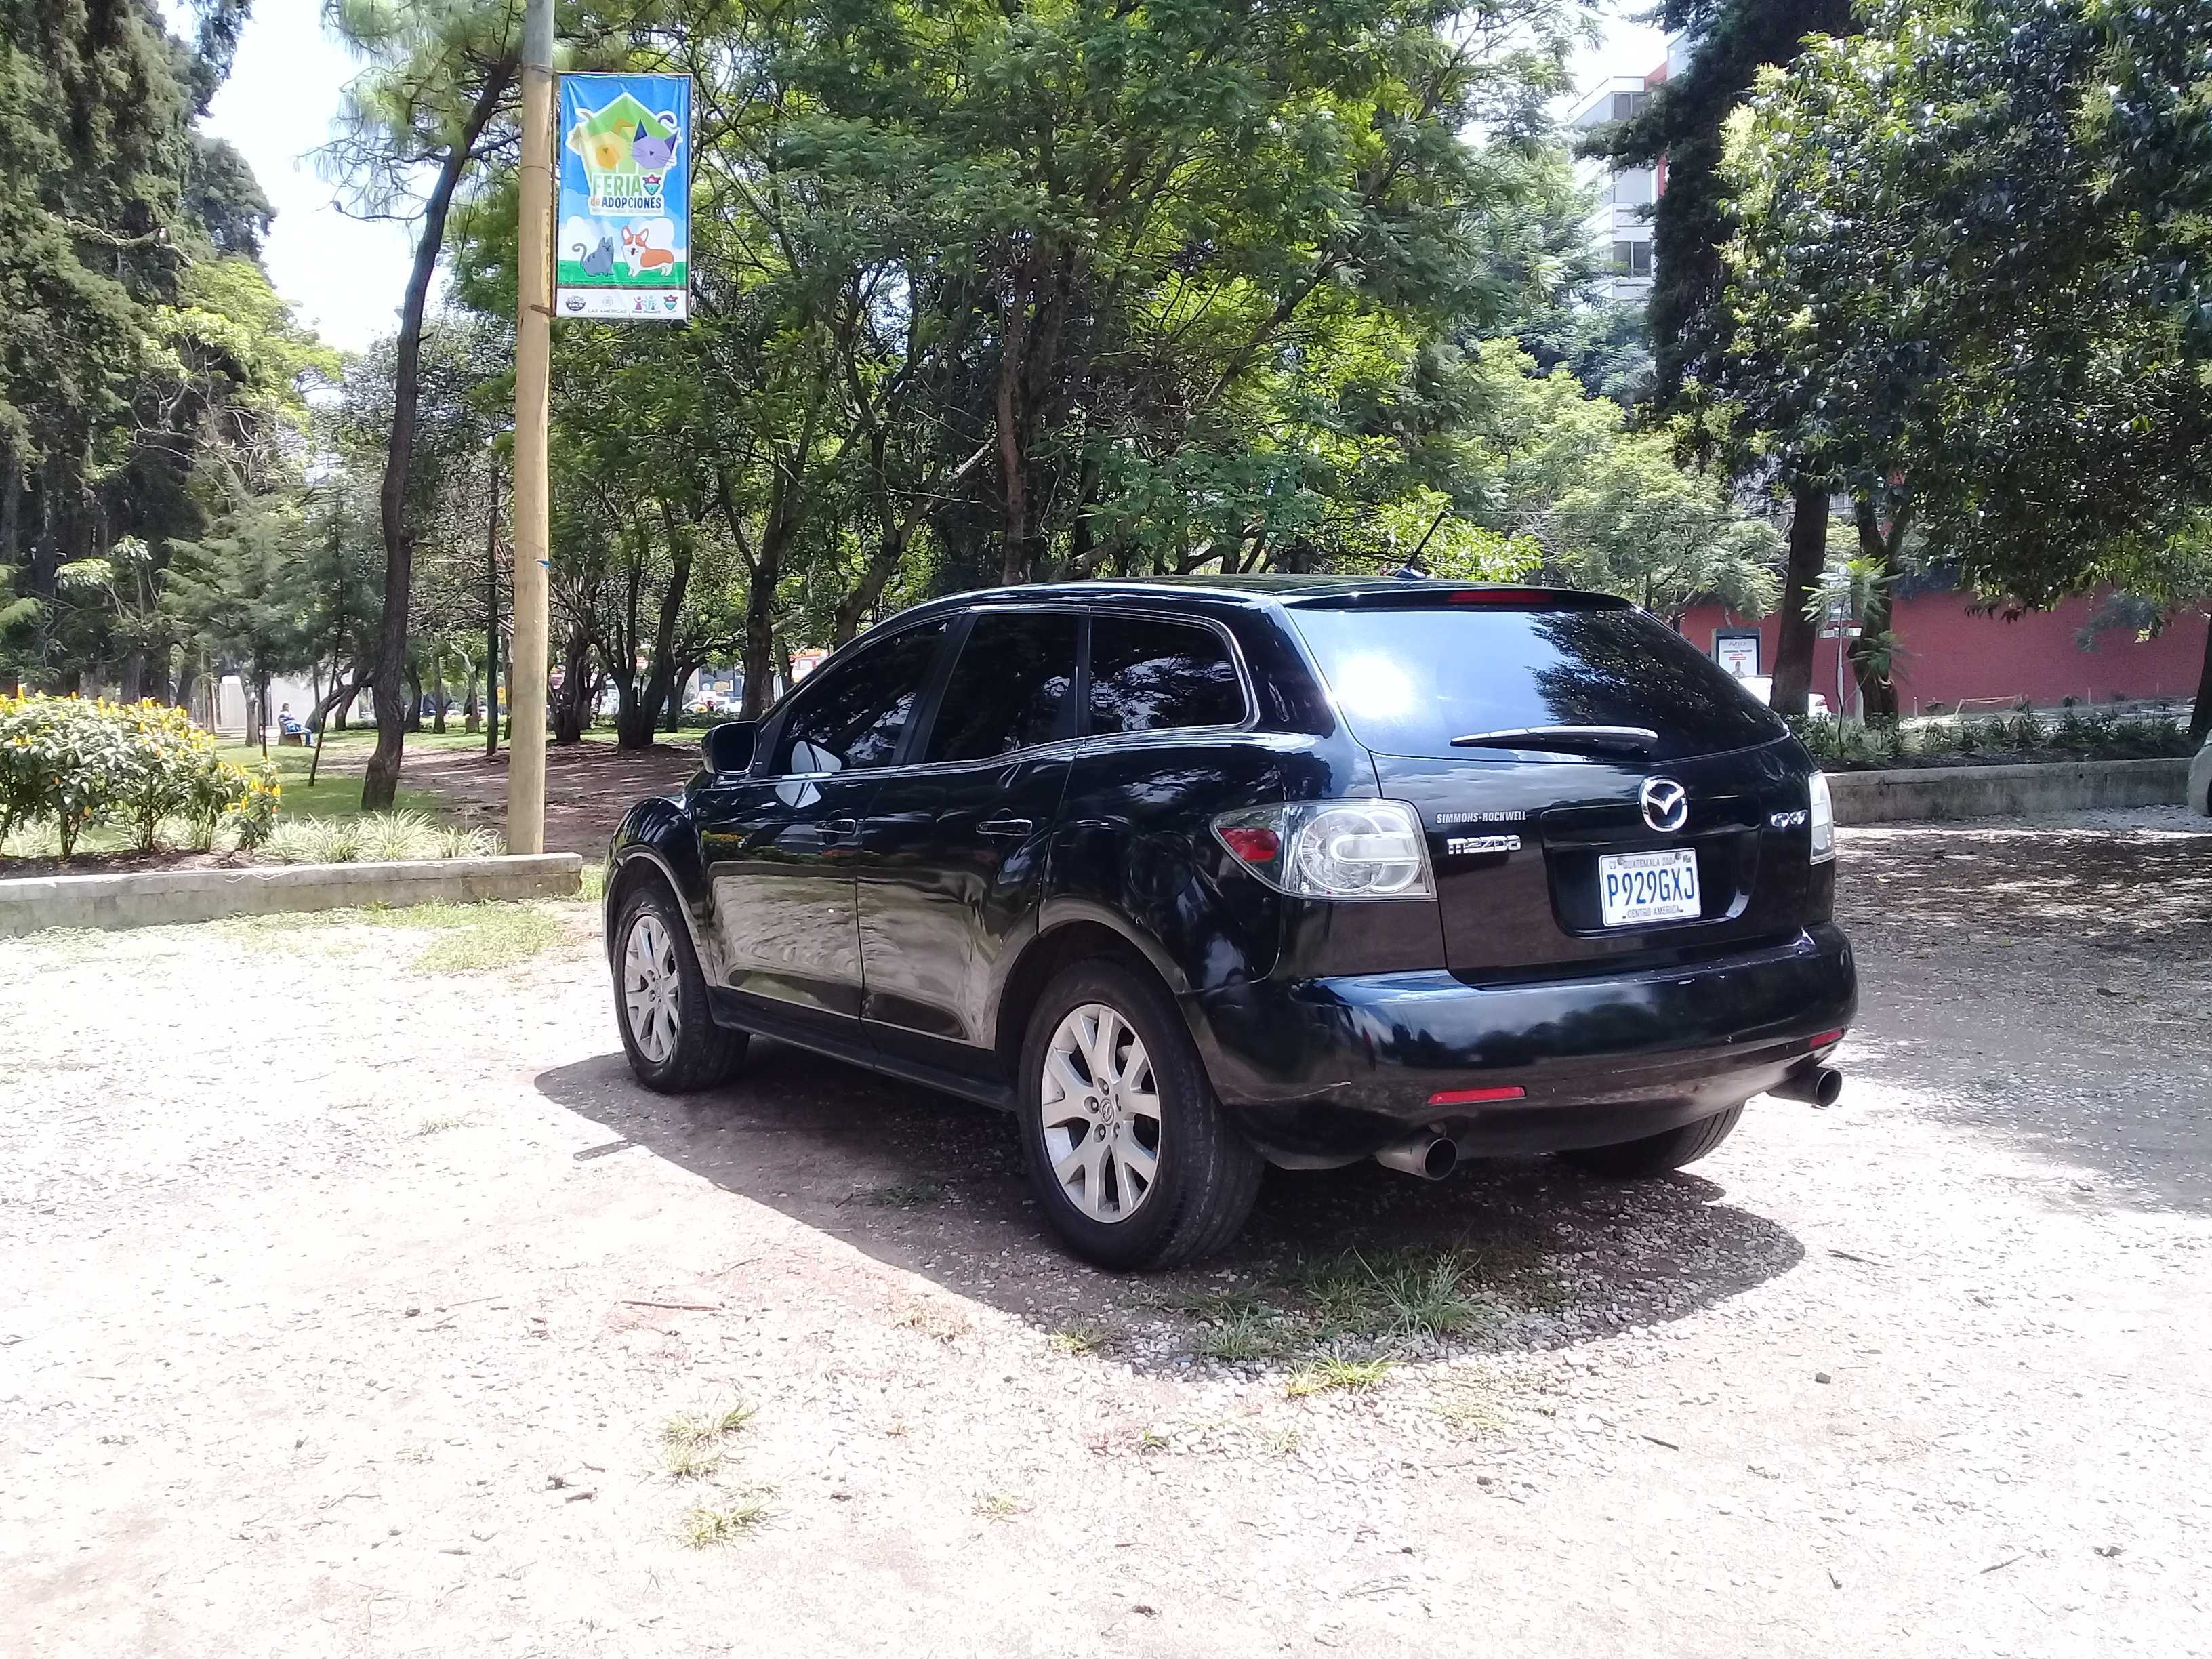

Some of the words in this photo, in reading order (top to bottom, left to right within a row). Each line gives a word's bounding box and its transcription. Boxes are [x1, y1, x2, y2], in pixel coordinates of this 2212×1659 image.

[593, 175, 642, 197] FERIA
[590, 195, 600, 207] de
[602, 196, 661, 209] ADOPCIONES
[1436, 811, 1526, 824] SIMMONS-ROCKWELL
[1606, 867, 1695, 907] P929GXJ
